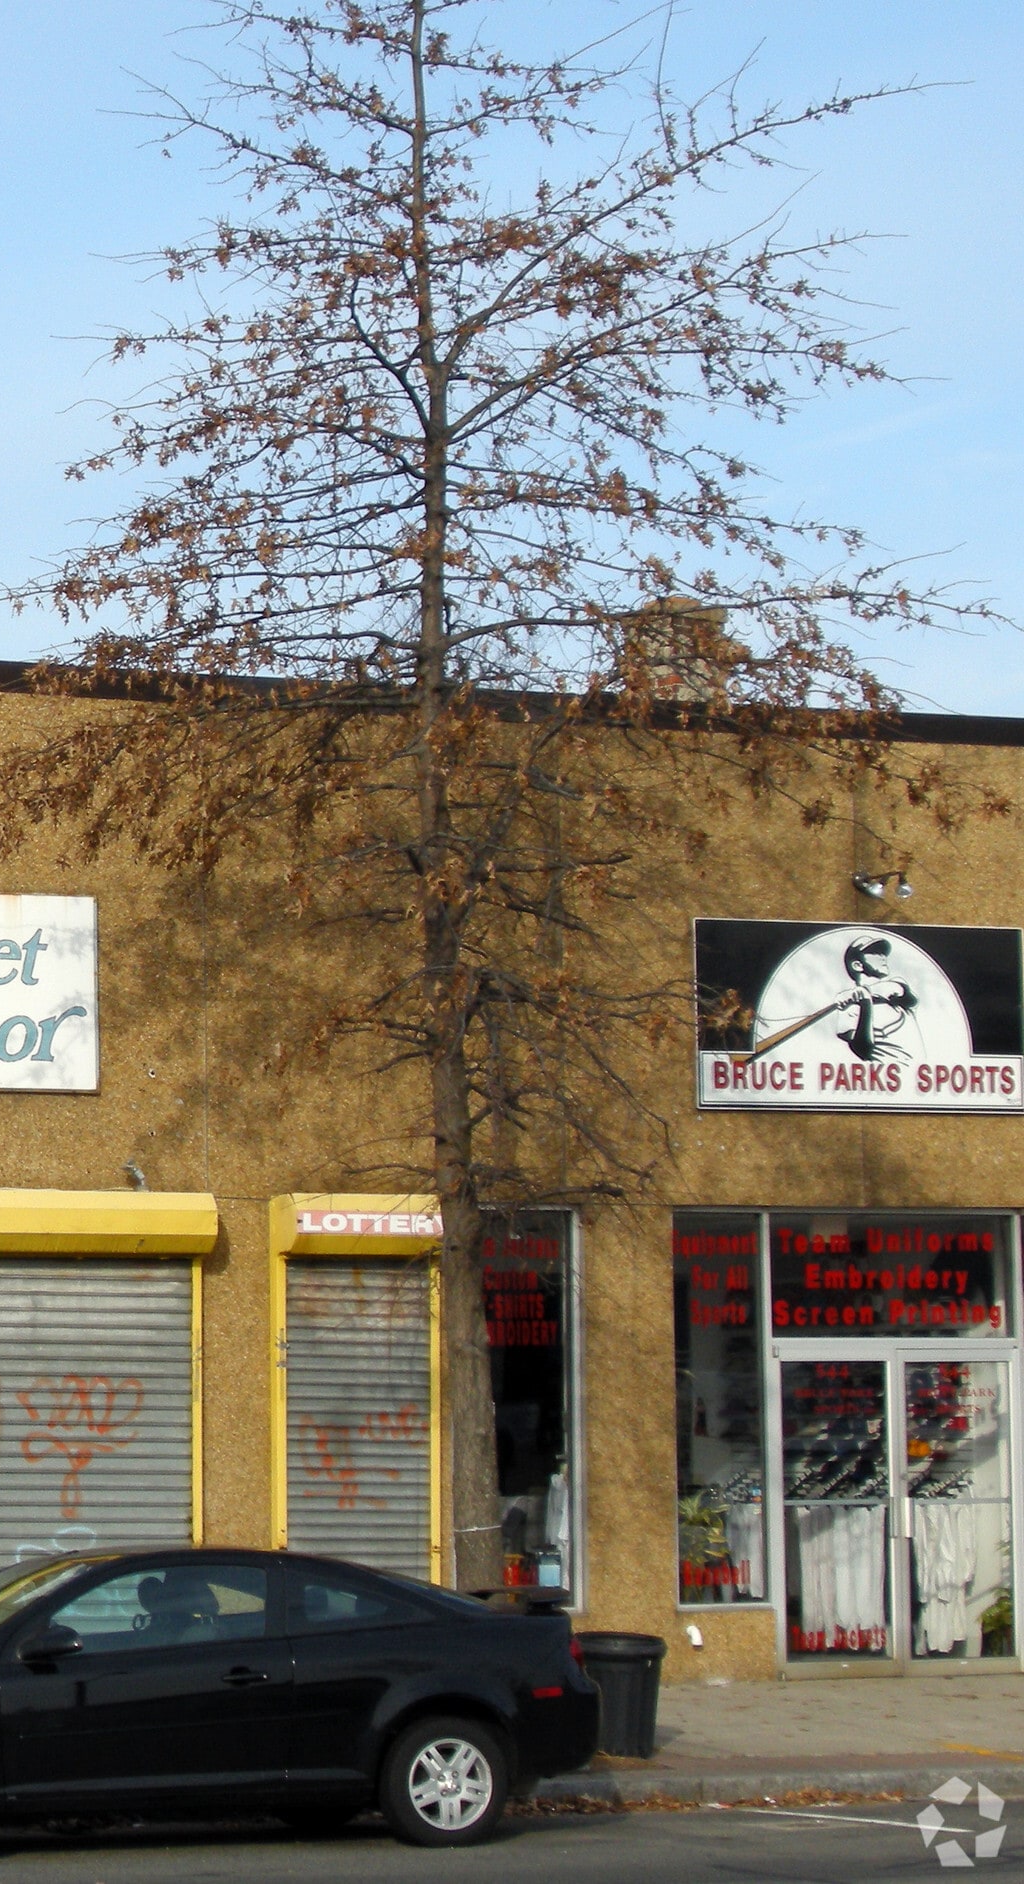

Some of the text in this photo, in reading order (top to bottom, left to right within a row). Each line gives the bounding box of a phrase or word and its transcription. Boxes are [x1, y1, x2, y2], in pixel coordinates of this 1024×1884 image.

[713, 1061, 1016, 1096] BRUCE PARKS SPORTS
[671, 1228, 758, 1261] Equipment
[777, 1227, 994, 1254] Team Uniforms
[691, 1265, 748, 1290] For All
[805, 1263, 968, 1295] Embroidery
[690, 1298, 746, 1331] Sports
[774, 1299, 1002, 1329] Screen Printing
[486, 1321, 558, 1346] BROIDERY
